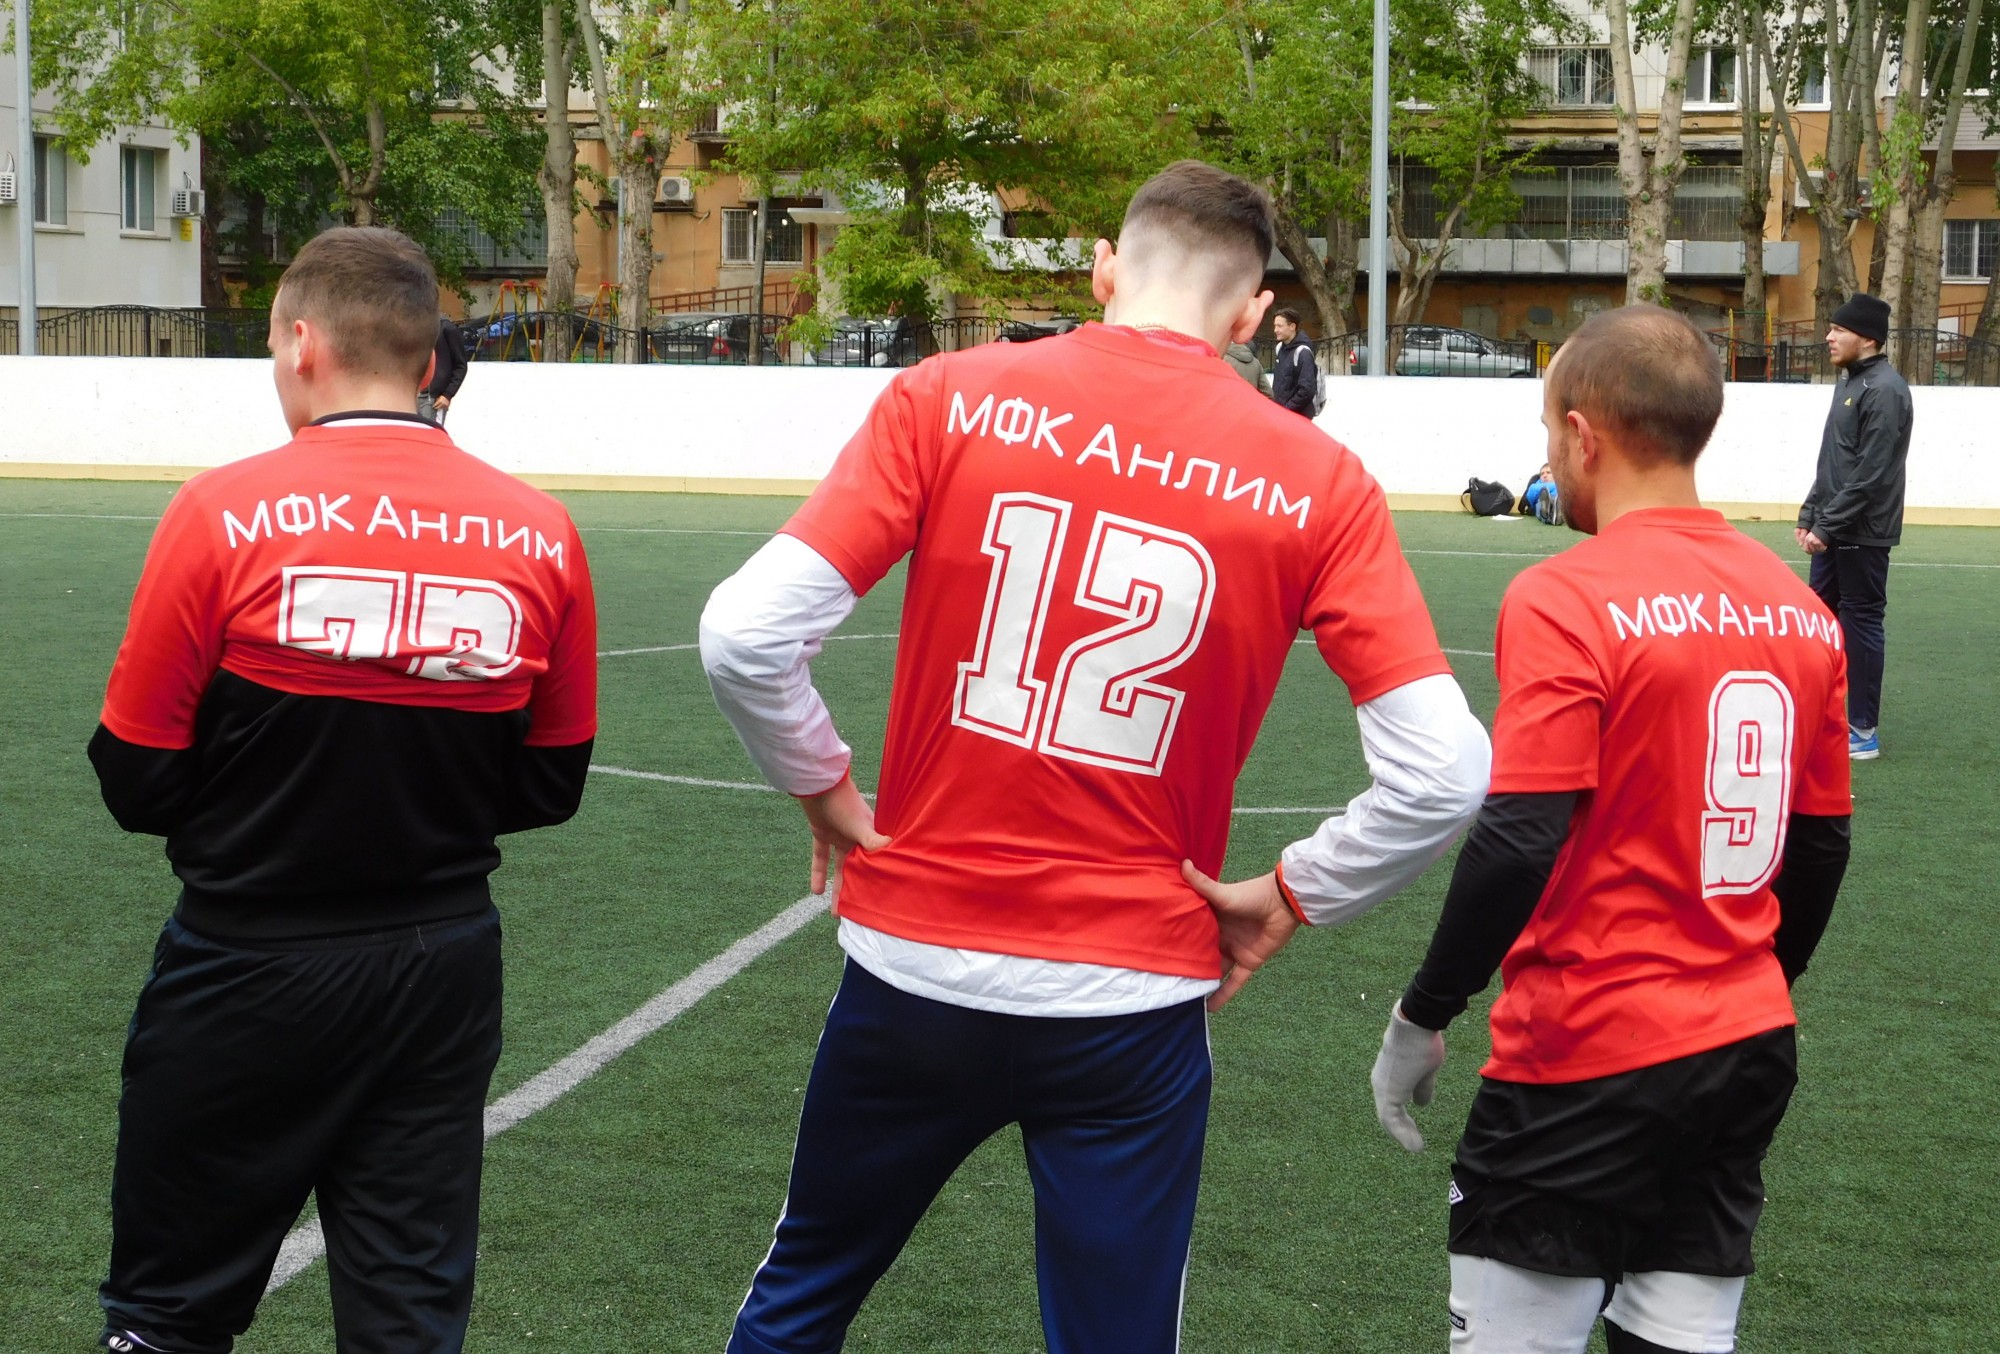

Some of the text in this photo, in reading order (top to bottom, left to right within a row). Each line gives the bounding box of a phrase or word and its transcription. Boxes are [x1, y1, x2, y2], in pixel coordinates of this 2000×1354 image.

[947, 391, 1074, 458] МФК
[222, 493, 355, 549] МФК
[951, 491, 1217, 777] 12
[1606, 592, 1713, 641] МФК
[1701, 670, 1795, 900] 9
